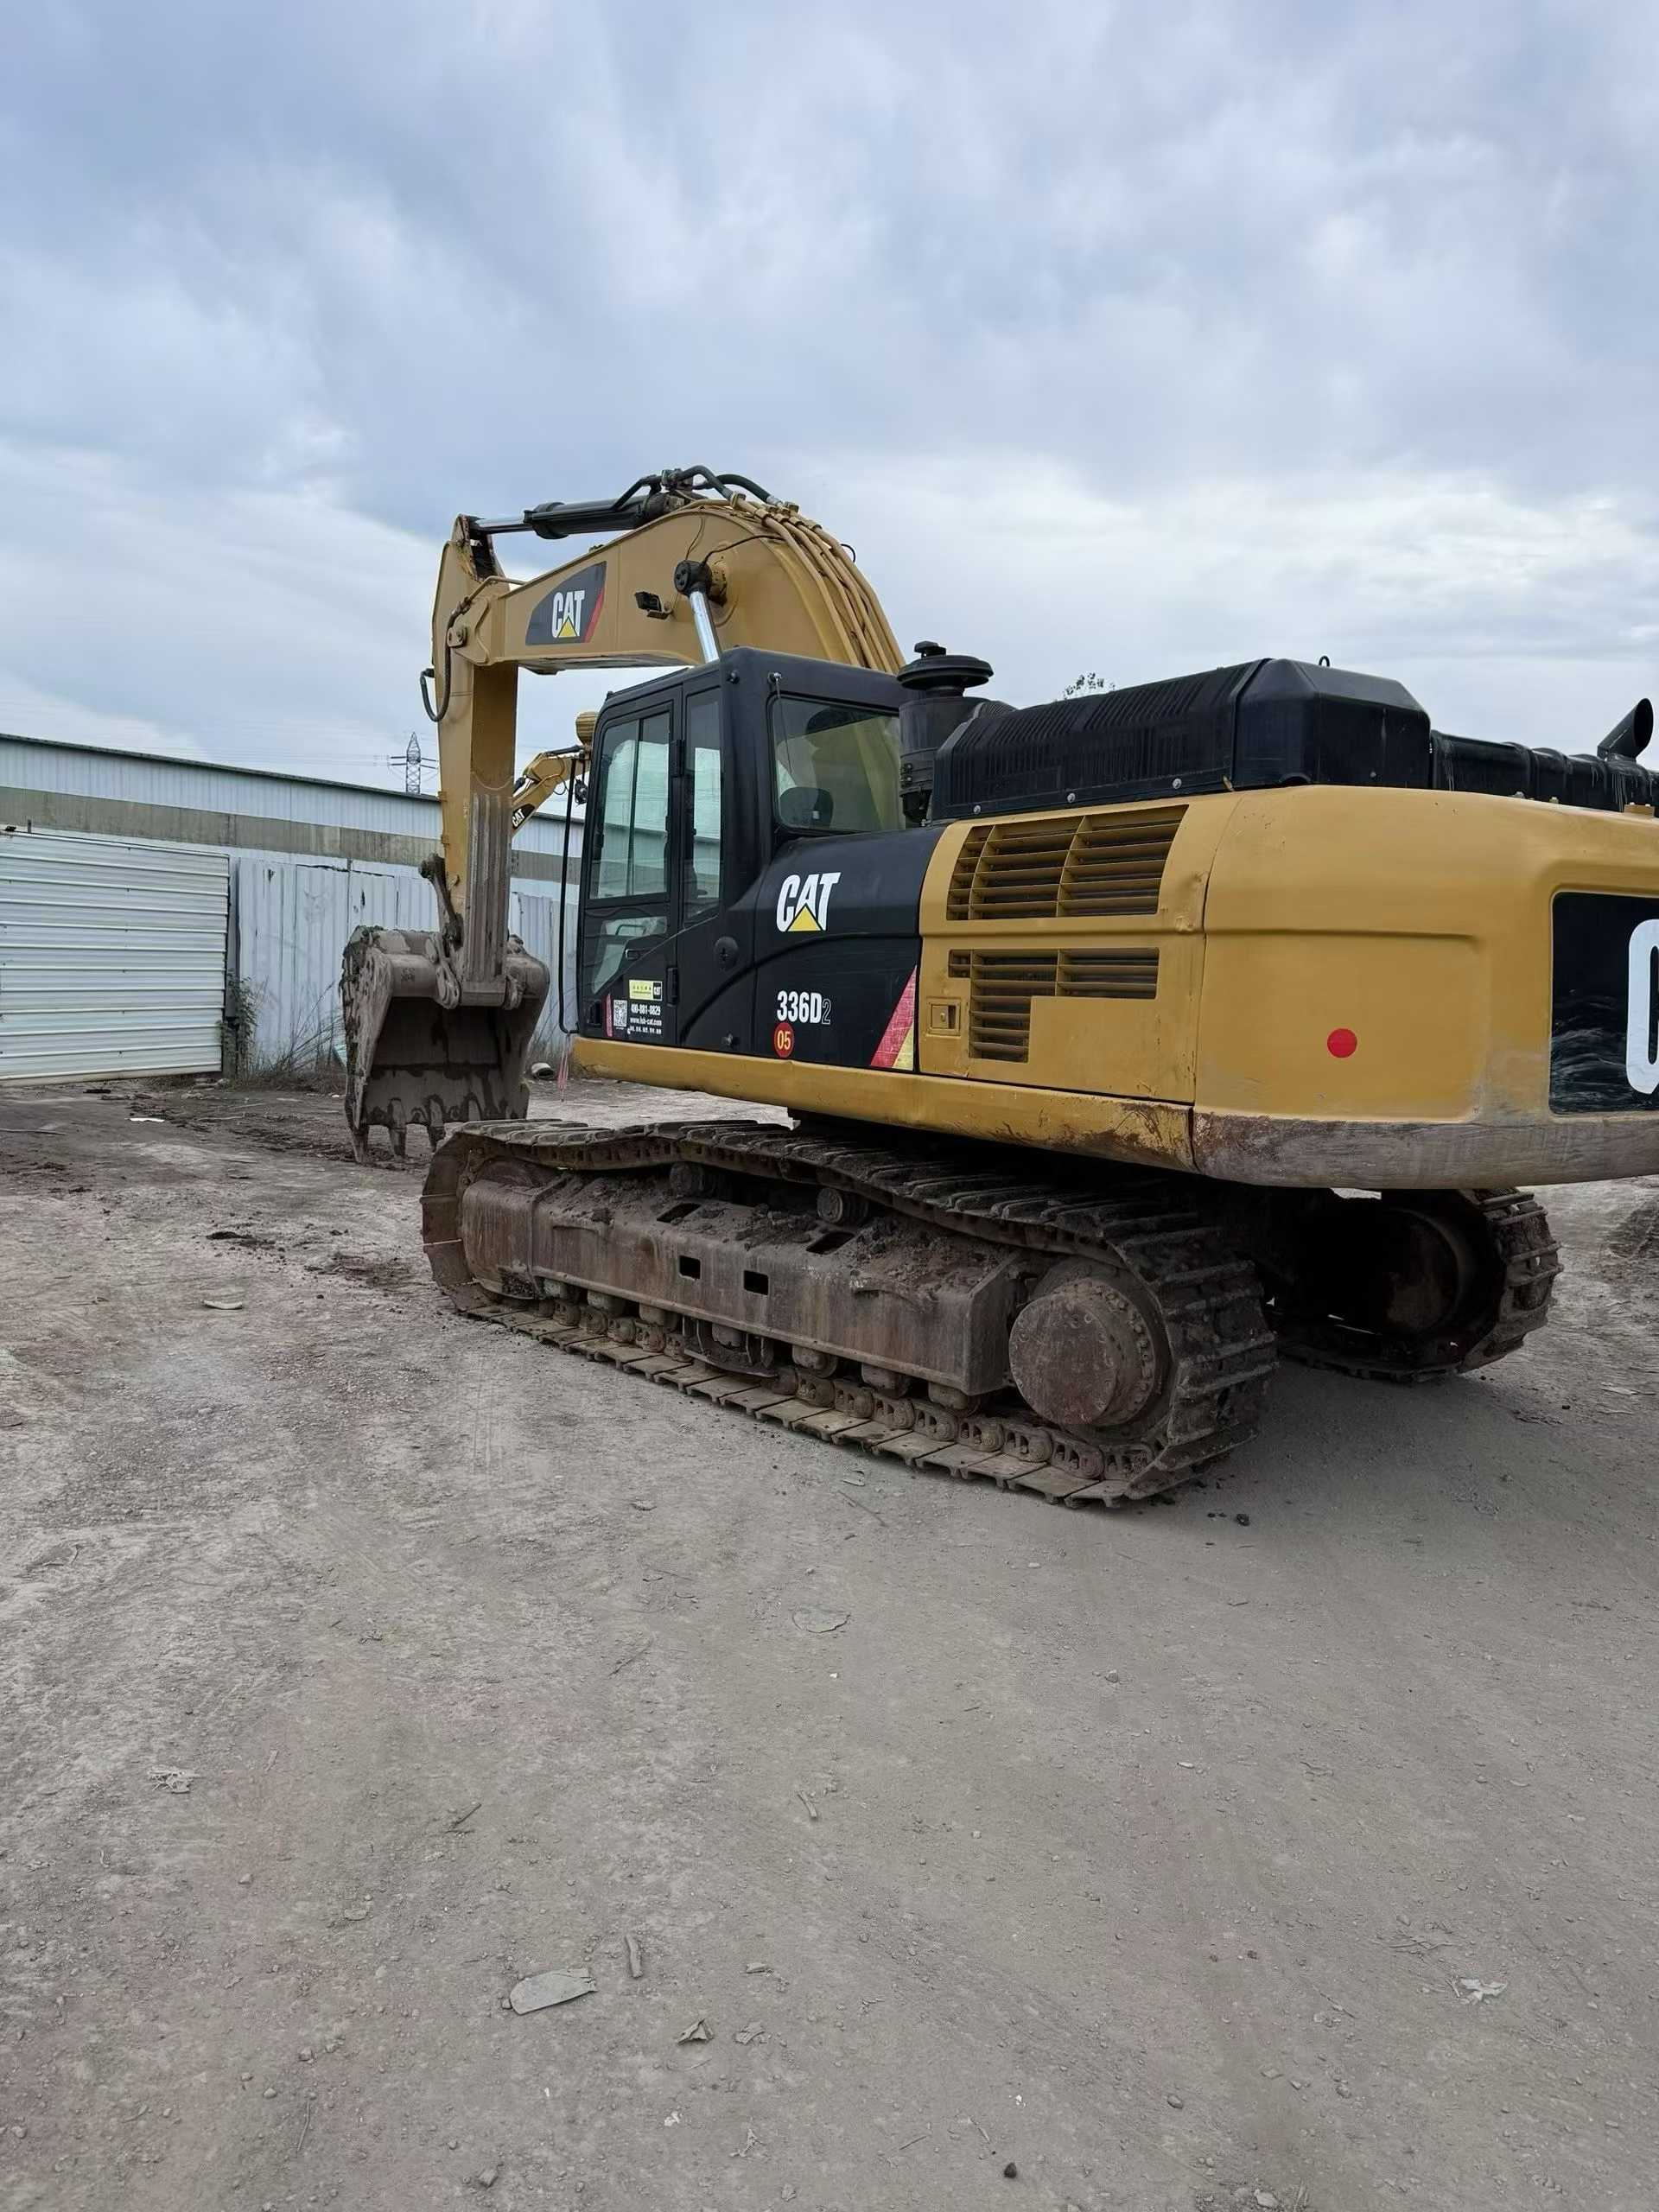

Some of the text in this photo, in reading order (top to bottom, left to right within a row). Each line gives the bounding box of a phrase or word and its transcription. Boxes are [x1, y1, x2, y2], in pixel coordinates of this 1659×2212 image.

[552, 590, 585, 638] CAT
[512, 809, 525, 827] CAT
[776, 872, 842, 931] CAT
[777, 1030, 791, 1050] 05
